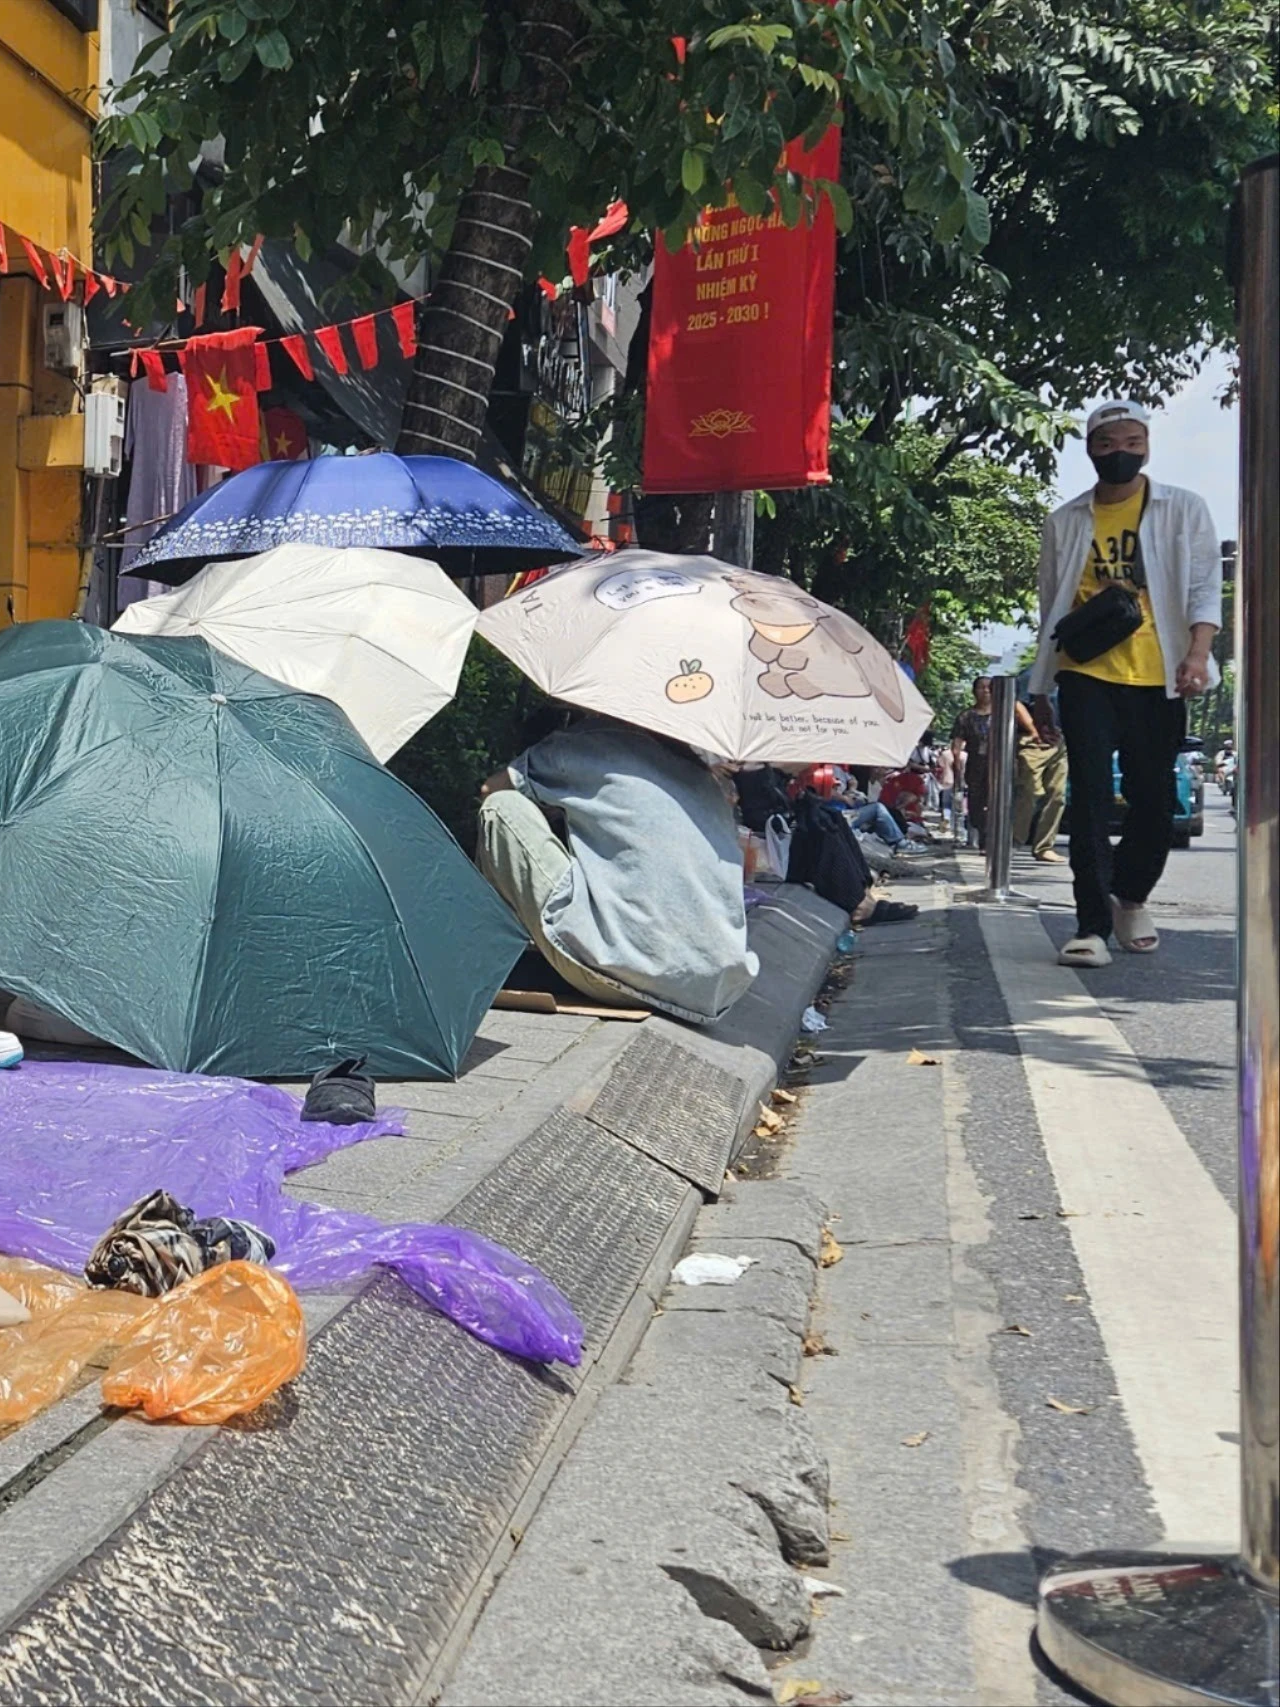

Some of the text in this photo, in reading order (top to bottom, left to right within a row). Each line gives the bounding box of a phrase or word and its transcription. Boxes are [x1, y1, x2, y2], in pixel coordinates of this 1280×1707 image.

[727, 242, 749, 268] THỨ
[751, 244, 760, 262] I
[696, 270, 758, 301] NHIỆM KỲ
[687, 311, 717, 331] 2025
[726, 303, 759, 324] 2030
[764, 302, 769, 320] !
[812, 714, 845, 724] because
[850, 716, 858, 725] of
[816, 724, 827, 733] for
